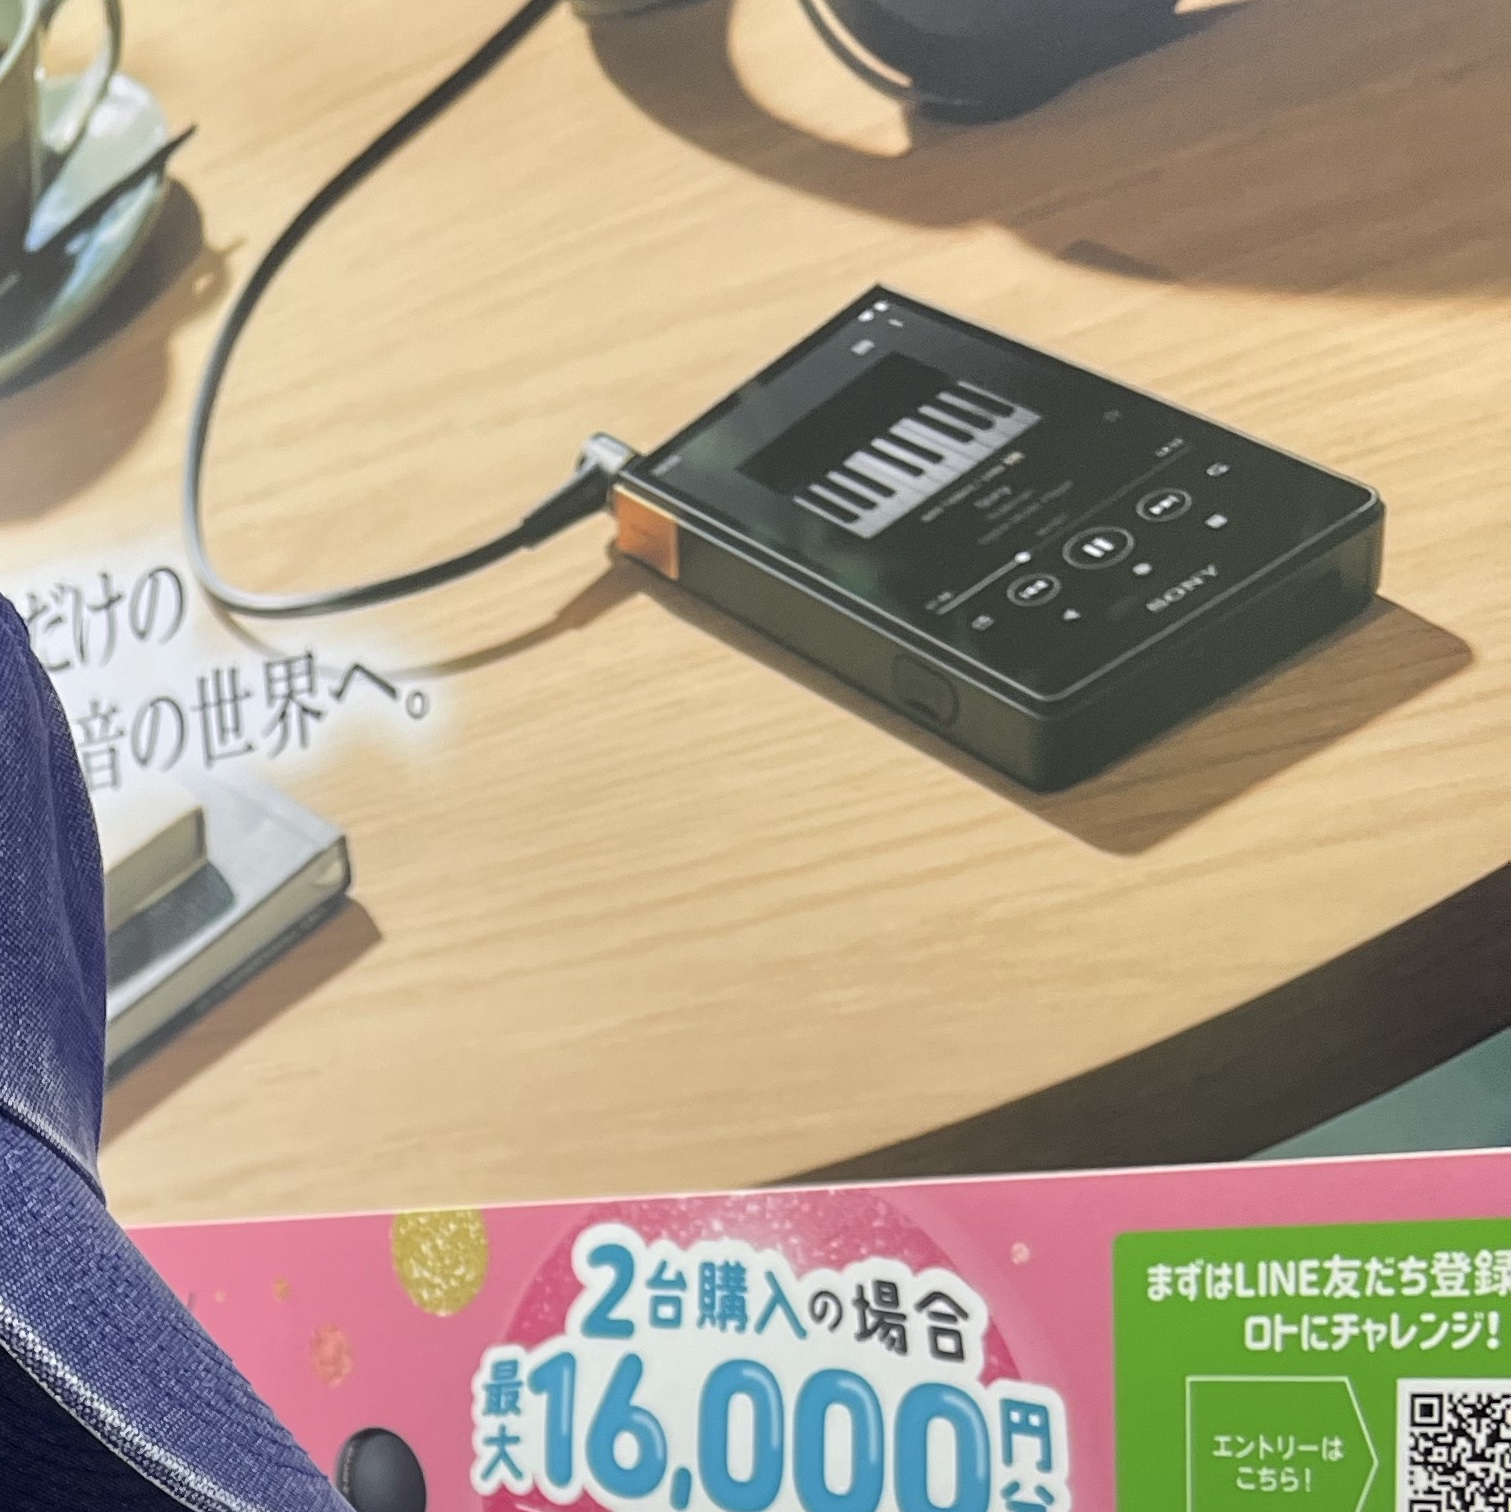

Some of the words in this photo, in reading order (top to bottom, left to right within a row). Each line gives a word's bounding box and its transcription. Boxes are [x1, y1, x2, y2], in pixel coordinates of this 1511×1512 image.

[76, 649, 431, 792] 音の世界へ。
[582, 1240, 970, 1364] 2台購入の場合
[1244, 1311, 1501, 1353] ロトにチャレンジ!
[1212, 1435, 1345, 1462] エントリーは
[1235, 1466, 1312, 1493] こちら!
